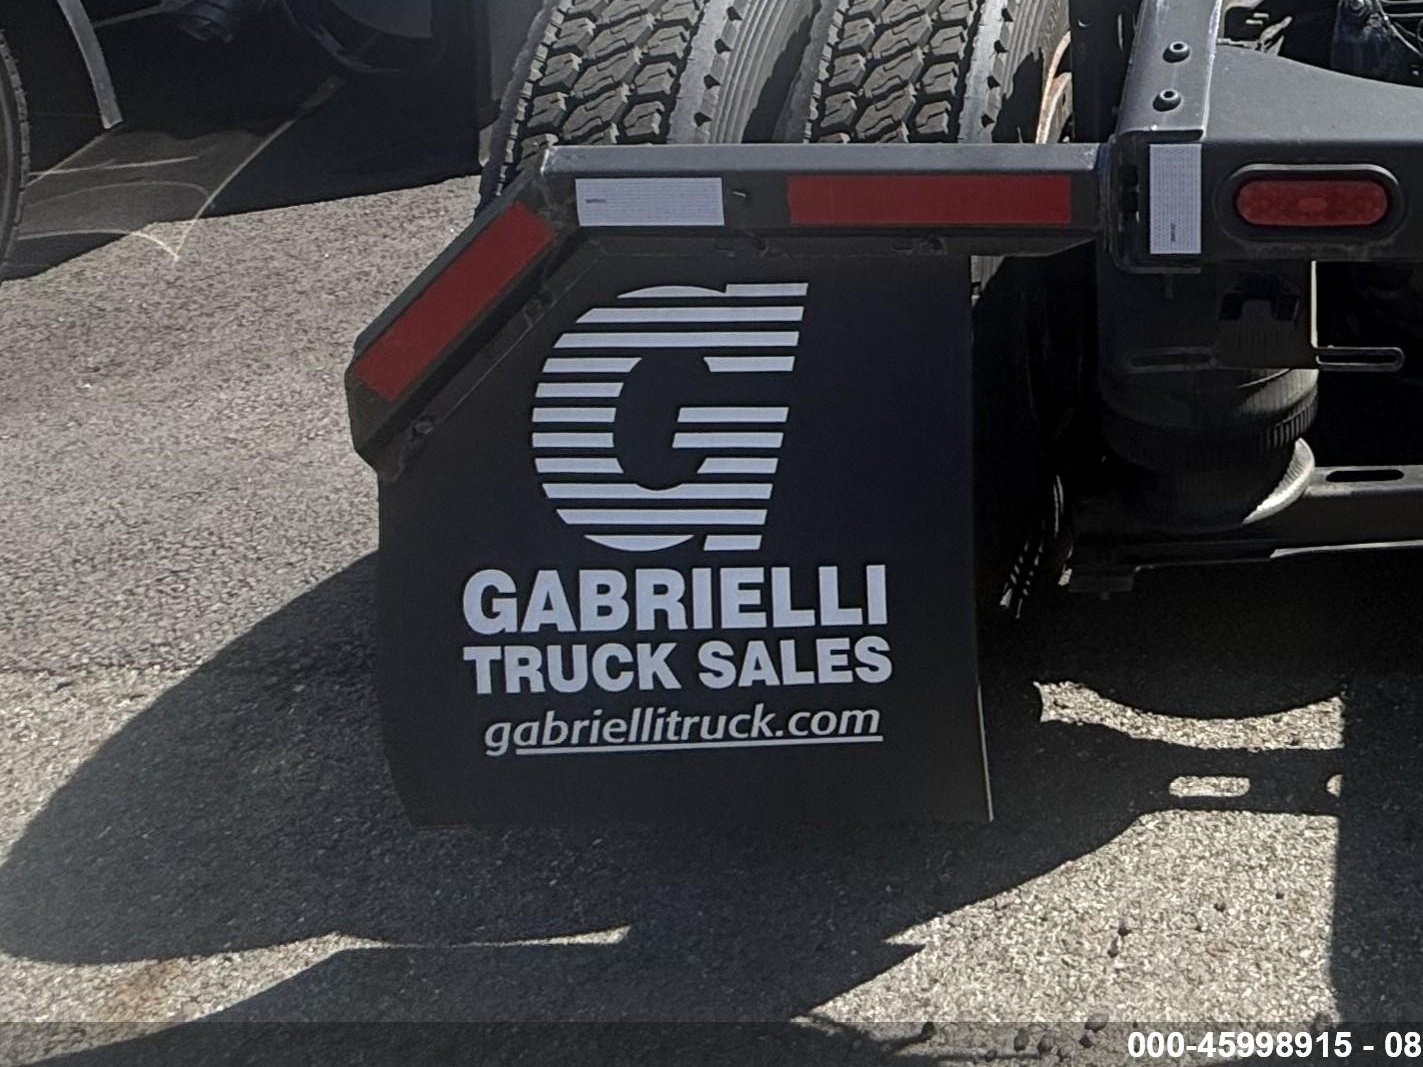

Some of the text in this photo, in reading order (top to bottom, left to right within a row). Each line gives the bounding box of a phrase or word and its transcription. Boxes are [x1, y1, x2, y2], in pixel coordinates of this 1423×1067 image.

[532, 282, 809, 552] G
[463, 564, 888, 636] GABRIELLI
[463, 635, 892, 694] TRUCK SALES
[484, 703, 884, 756] gabriellitruck.com
